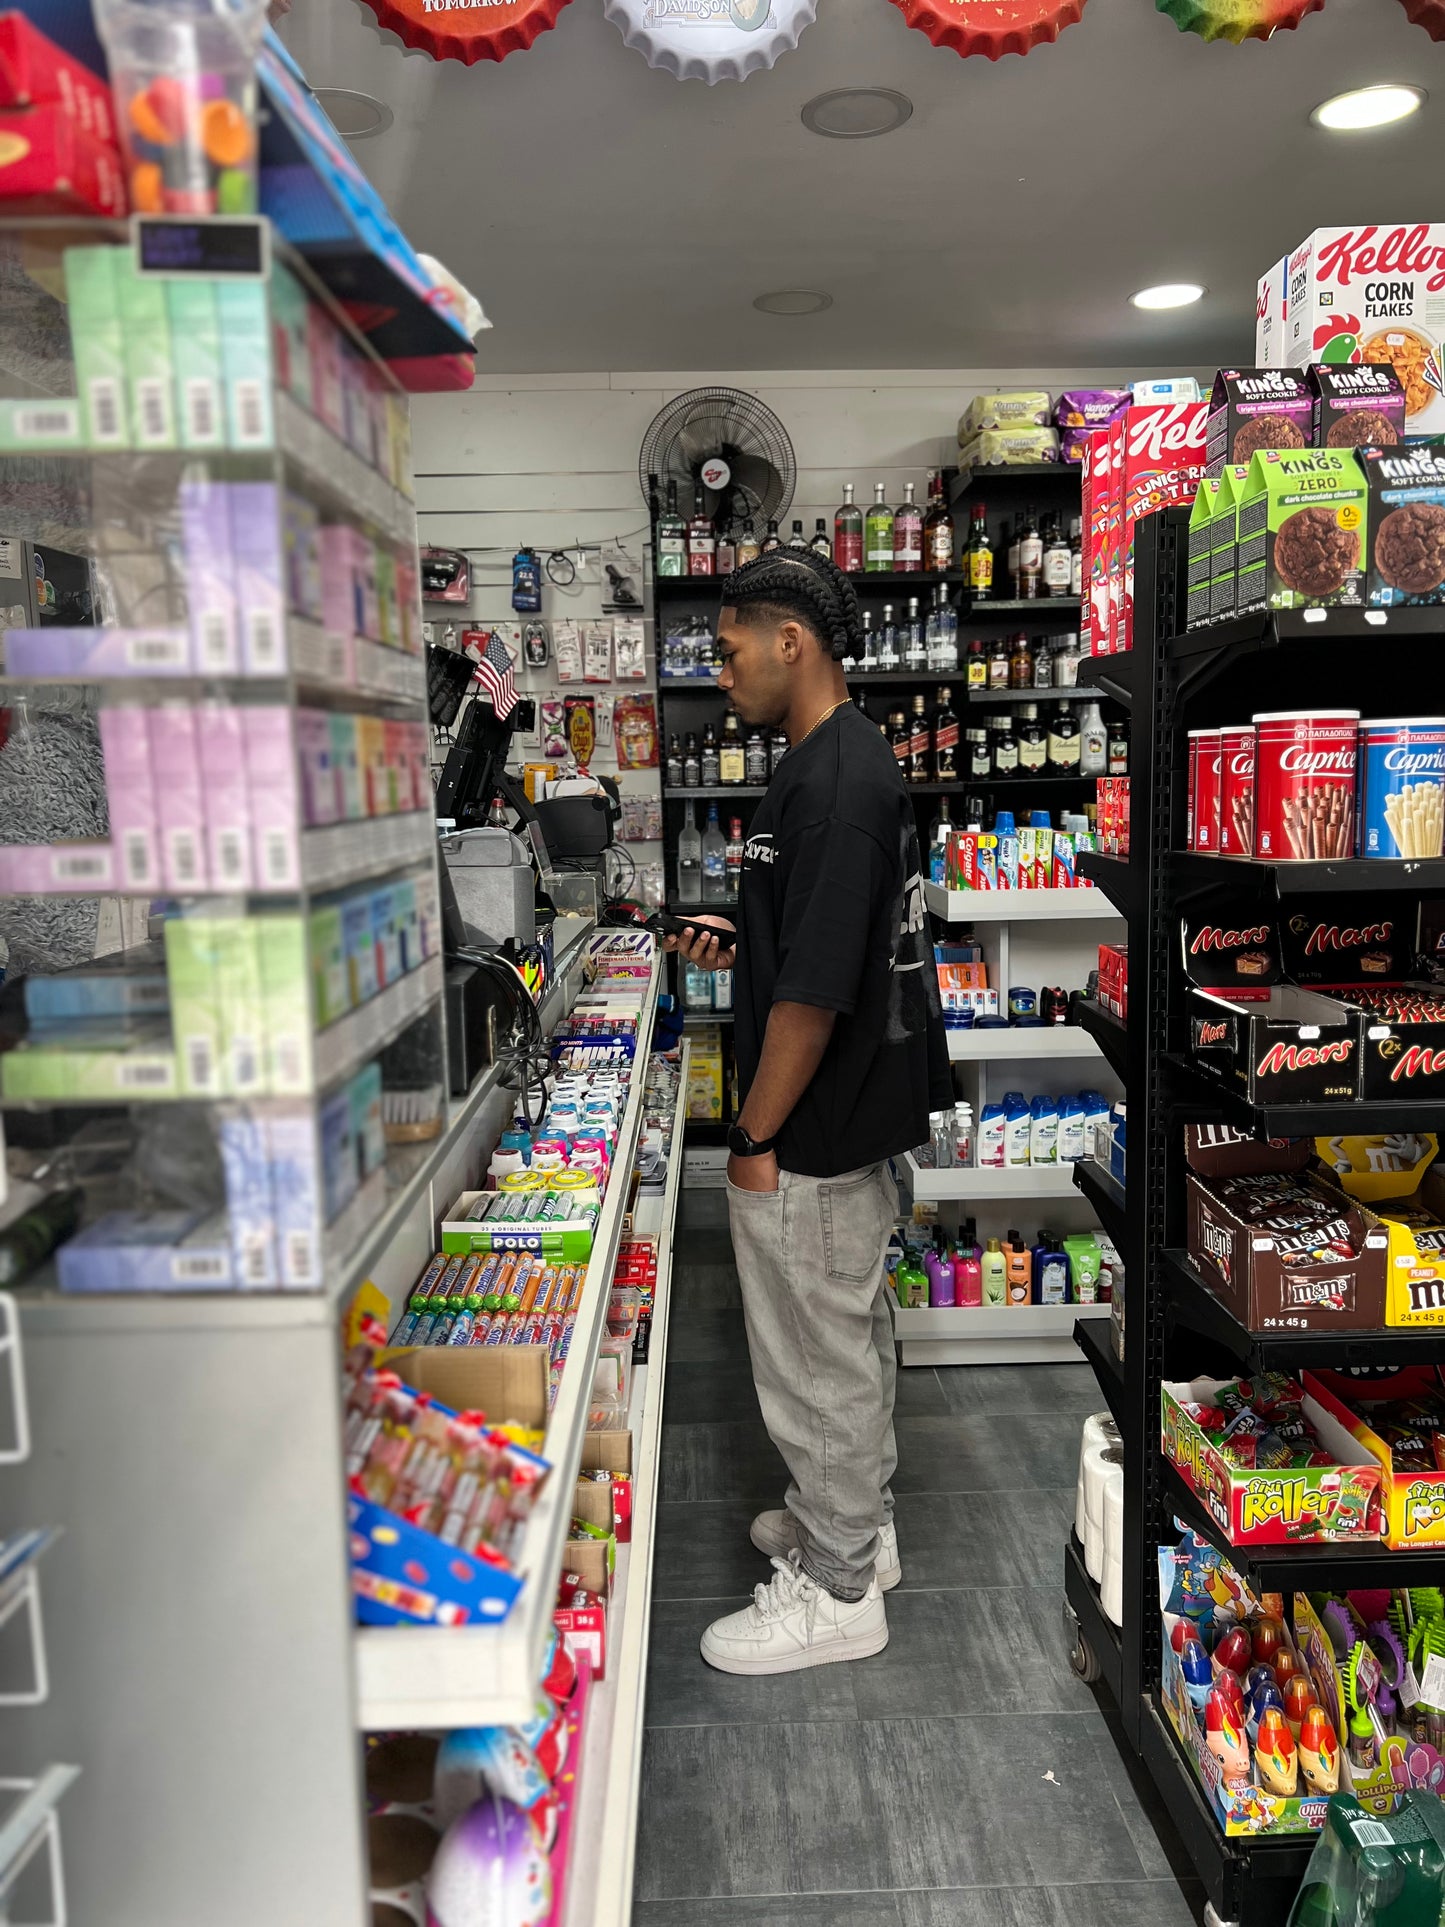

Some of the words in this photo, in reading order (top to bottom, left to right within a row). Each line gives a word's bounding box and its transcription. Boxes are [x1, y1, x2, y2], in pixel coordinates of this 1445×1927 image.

[655, 0, 730, 19] DAVIDSON
[1291, 268, 1307, 295] CORN
[1365, 281, 1414, 302] CORN
[1365, 302, 1413, 318] FLAKES
[1236, 376, 1298, 394] KINGS
[1329, 371, 1390, 389] KINGS
[1245, 392, 1266, 400] SOFT
[1266, 391, 1298, 399] COOKIE
[1359, 386, 1391, 394] COOKIE
[1280, 457, 1343, 475] KINGS
[1379, 459, 1445, 478] KINGS
[1298, 477, 1337, 491] ZERO
[1391, 477, 1415, 486] SOFT
[1284, 494, 1301, 504] dark
[1301, 492, 1333, 502] chocolate
[1334, 489, 1358, 499] chunks
[1270, 593, 1282, 603] 4x
[1280, 745, 1356, 774] Caprice
[964, 837, 975, 880] Colgate
[1191, 926, 1270, 954] Mars
[1305, 922, 1393, 955] Mars
[1200, 1021, 1227, 1046] Mars
[1385, 1041, 1401, 1054] 2x
[1257, 1040, 1353, 1076] Mars
[493, 1237, 540, 1249] POLO
[417, 1267, 442, 1294] mentos
[436, 1267, 459, 1294] mentos
[453, 1266, 475, 1293] mentos
[474, 1266, 496, 1294] mentos
[511, 1267, 530, 1295] mentos
[1410, 1269, 1435, 1277] PEANUT
[534, 1279, 551, 1306] mentos
[1292, 1279, 1348, 1303] m&m's
[1264, 1318, 1276, 1327] 24
[1286, 1318, 1299, 1327] 45
[1301, 1320, 1308, 1329] g
[1400, 1314, 1412, 1322] 24
[1423, 1314, 1435, 1322] 45
[1438, 1315, 1444, 1323] g
[559, 1325, 575, 1359] mentos
[1208, 1490, 1229, 1528] Fini
[1242, 1478, 1340, 1531] Roller
[1322, 1529, 1336, 1538] 40
[1357, 1782, 1405, 1799] LOLLIPOP
